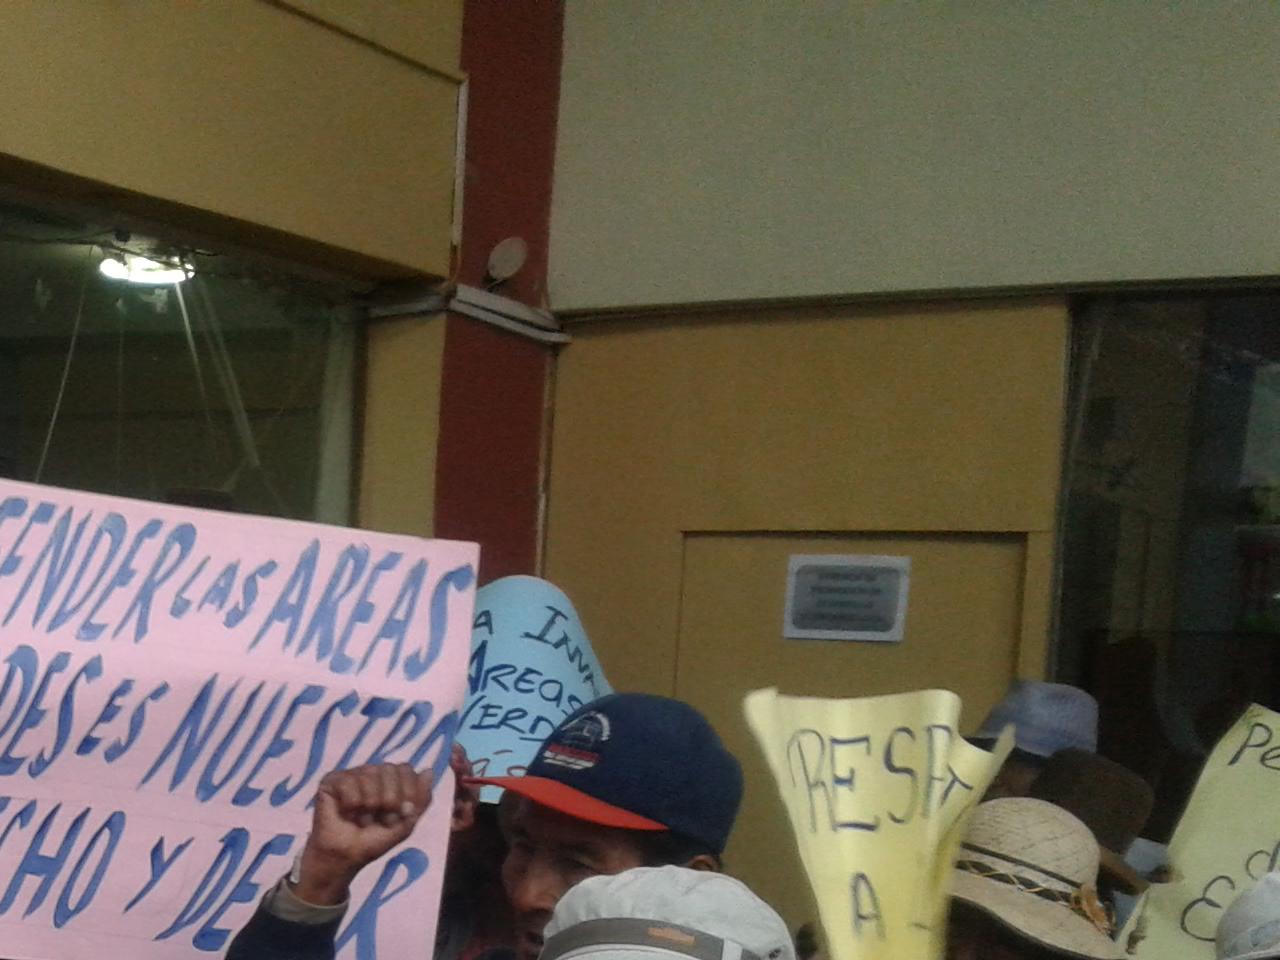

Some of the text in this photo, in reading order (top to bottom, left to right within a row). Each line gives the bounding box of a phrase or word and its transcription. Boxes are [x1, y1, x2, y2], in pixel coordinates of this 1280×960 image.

[173, 555, 277, 630] LAS
[246, 538, 476, 682] AREAS
[75, 679, 170, 763] ES
[124, 836, 194, 913] Y
